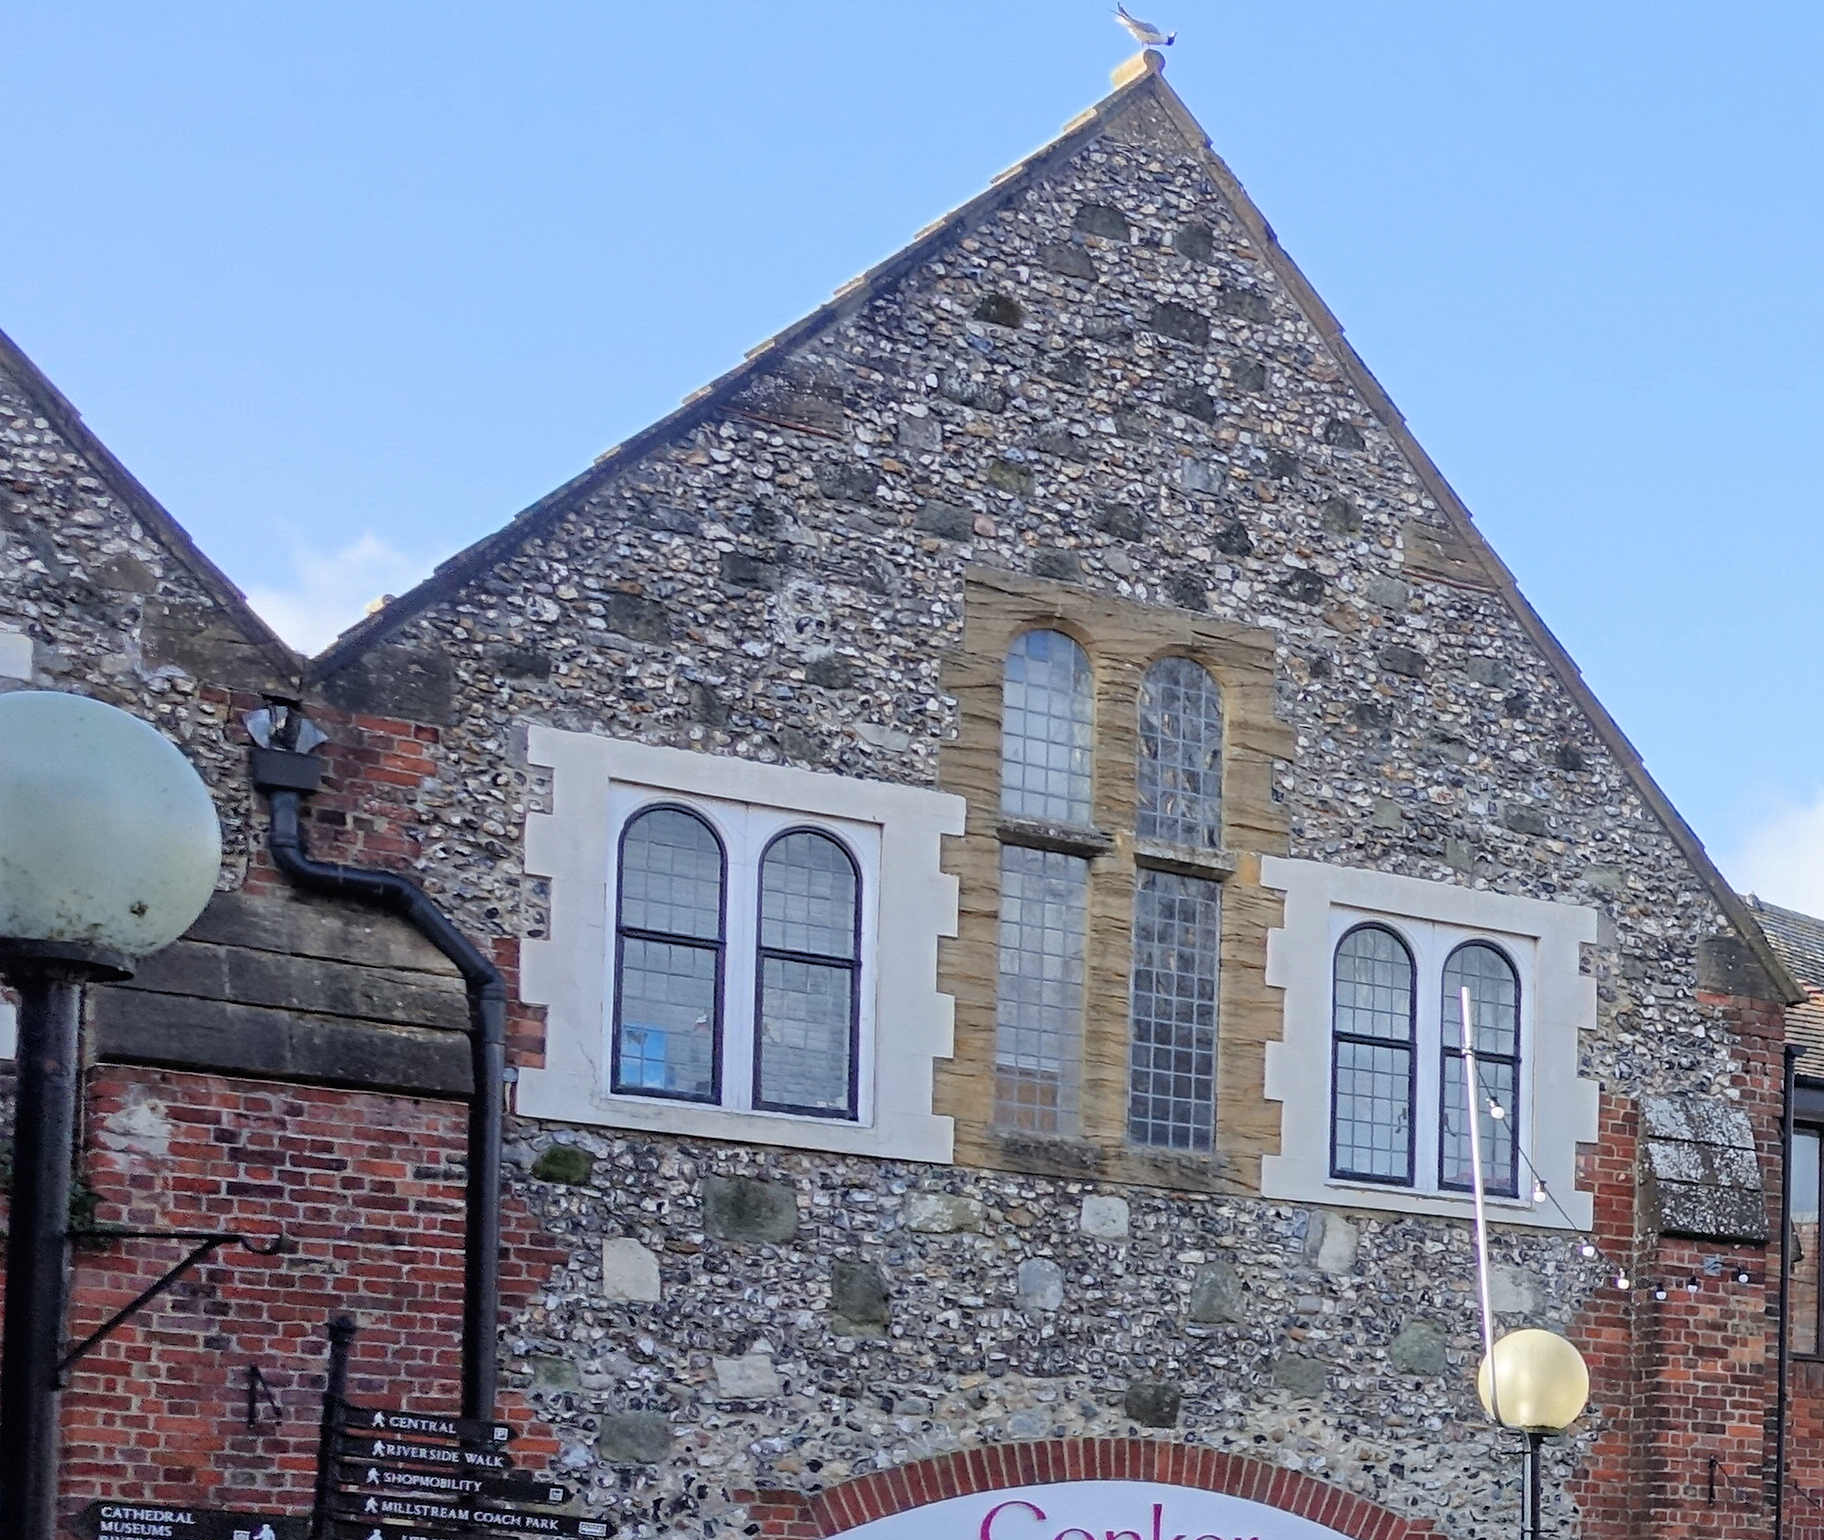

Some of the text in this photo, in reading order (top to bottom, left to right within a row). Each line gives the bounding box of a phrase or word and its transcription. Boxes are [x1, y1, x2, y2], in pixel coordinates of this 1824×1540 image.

[389, 1416, 457, 1435] CENTRAL
[386, 1444, 505, 1468] RIVERSIDE WALK
[383, 1472, 483, 1493] SHOPMOBILITY
[100, 1506, 197, 1525] CATHEDRAL
[381, 1501, 559, 1531] MILLSTREAM COACH PARK
[100, 1521, 173, 1537] MUSEUMS
